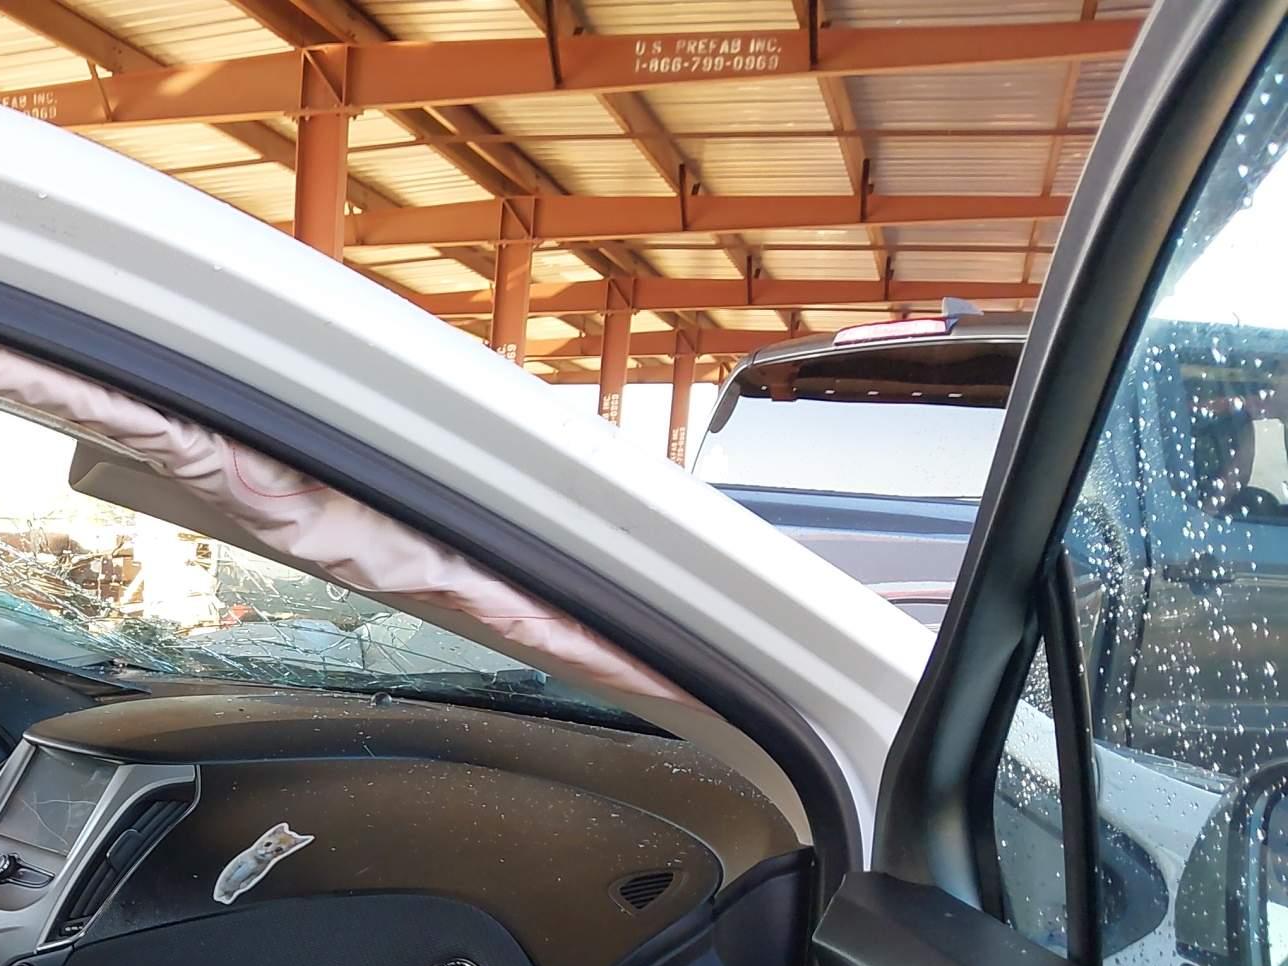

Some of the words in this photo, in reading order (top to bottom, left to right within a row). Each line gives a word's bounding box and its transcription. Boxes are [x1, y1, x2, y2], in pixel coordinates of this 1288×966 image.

[635, 40, 646, 55] U
[651, 40, 662, 54] S
[675, 38, 741, 54] PREFAB
[749, 37, 782, 53] INC.
[33, 91, 57, 105] INC.
